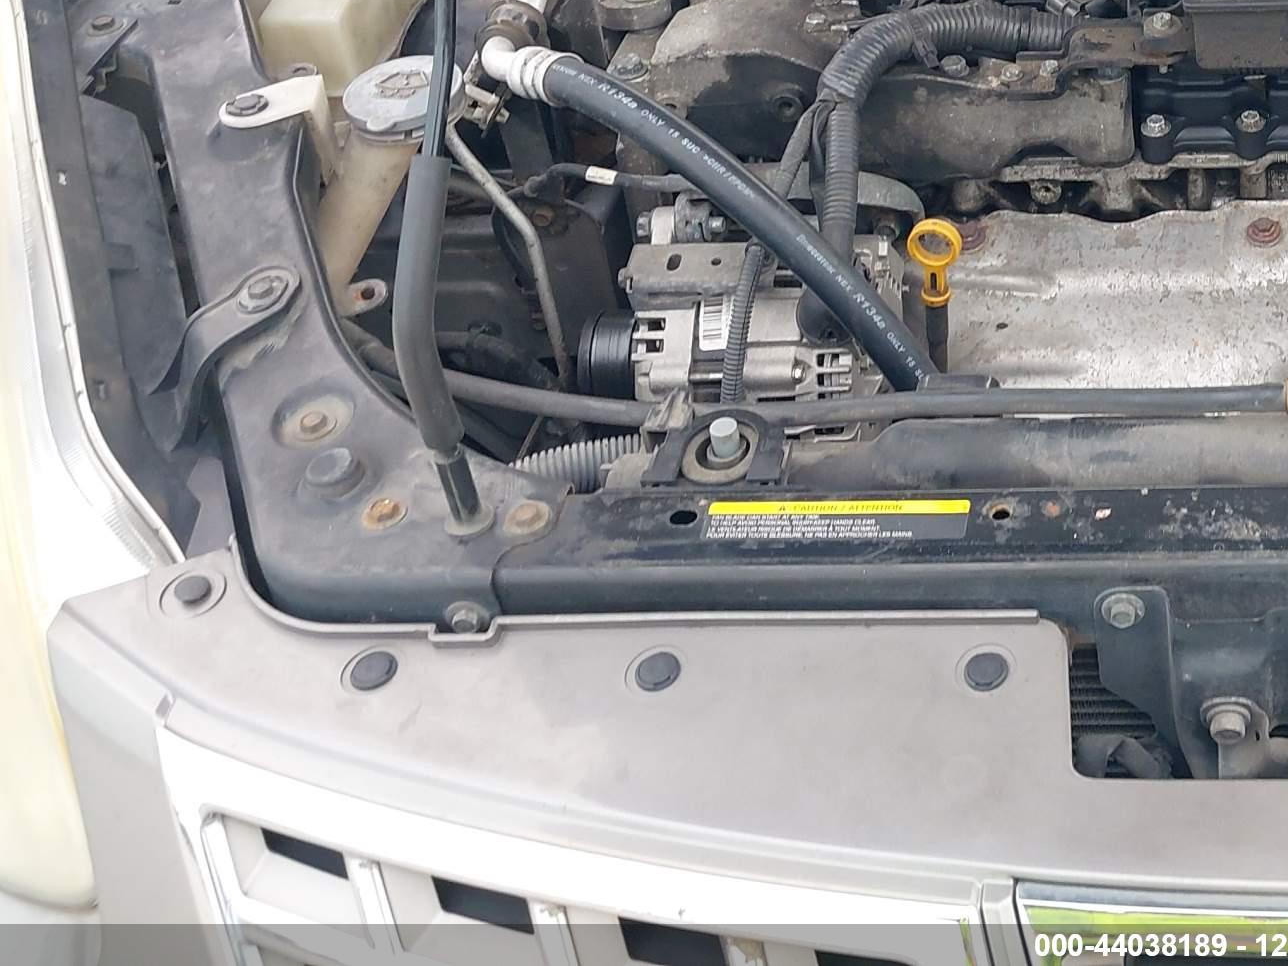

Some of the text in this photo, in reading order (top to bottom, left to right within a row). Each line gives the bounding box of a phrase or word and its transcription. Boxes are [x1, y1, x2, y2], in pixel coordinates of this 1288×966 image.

[598, 81, 639, 110] R134a
[640, 108, 666, 128] ONLY
[853, 291, 887, 331] R134a
[886, 332, 907, 354] ONLY
[793, 504, 839, 512] CAUTION
[848, 503, 903, 512] ATTENTION
